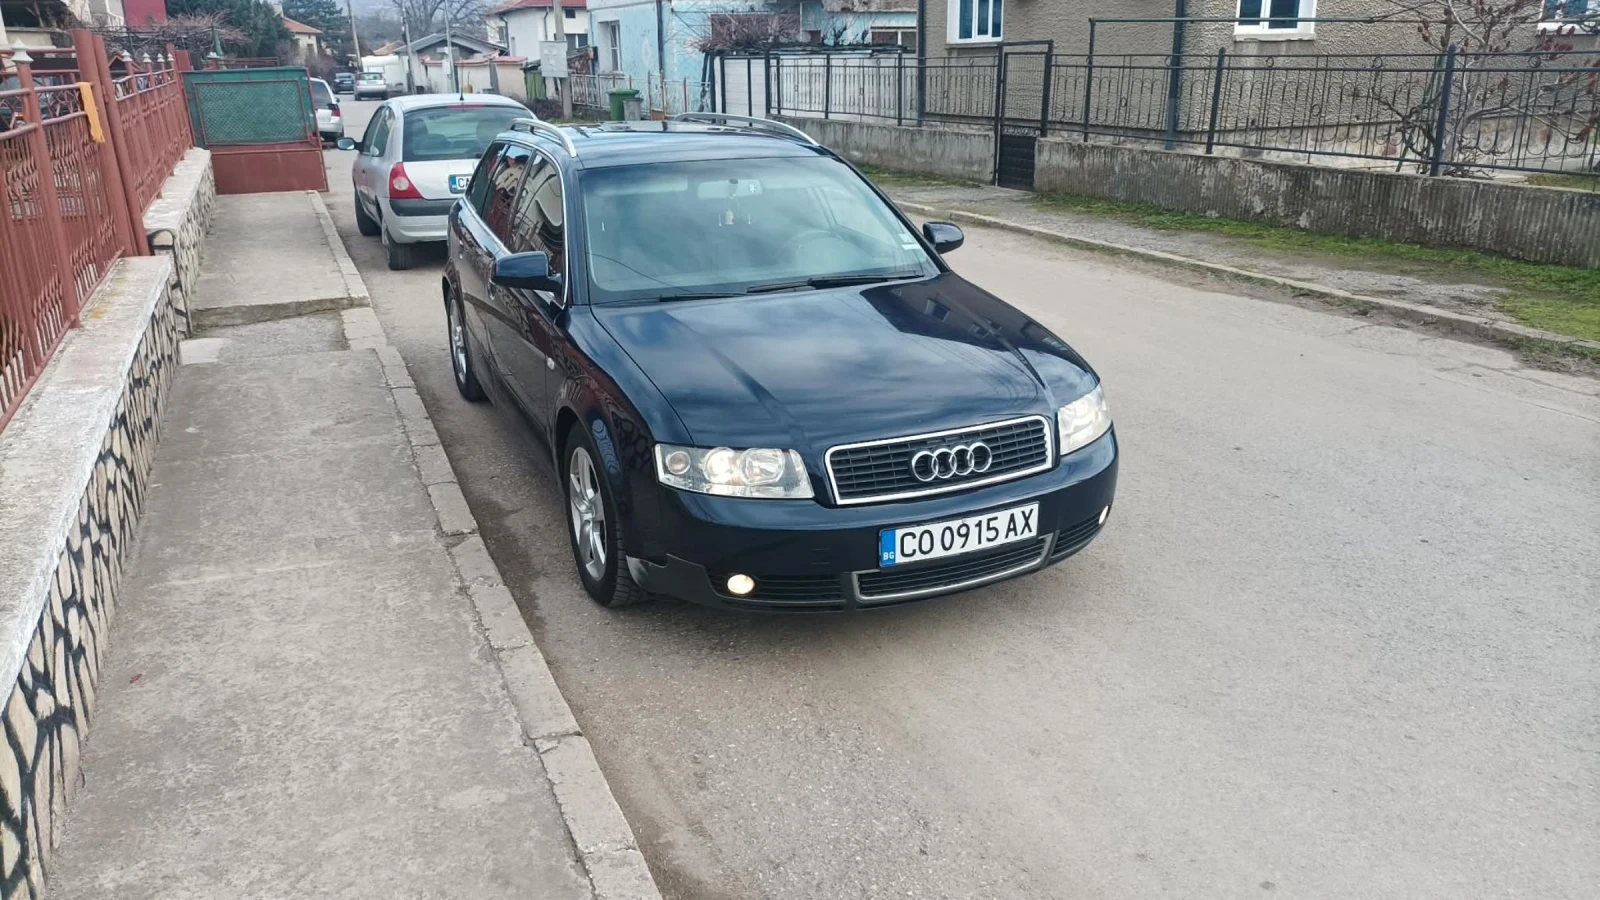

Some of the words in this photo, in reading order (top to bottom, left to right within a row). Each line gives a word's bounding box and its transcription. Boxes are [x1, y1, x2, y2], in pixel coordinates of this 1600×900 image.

[900, 530, 934, 558] CO
[941, 516, 999, 551] 0915
[1005, 508, 1034, 539] AX
[883, 551, 895, 560] BG
